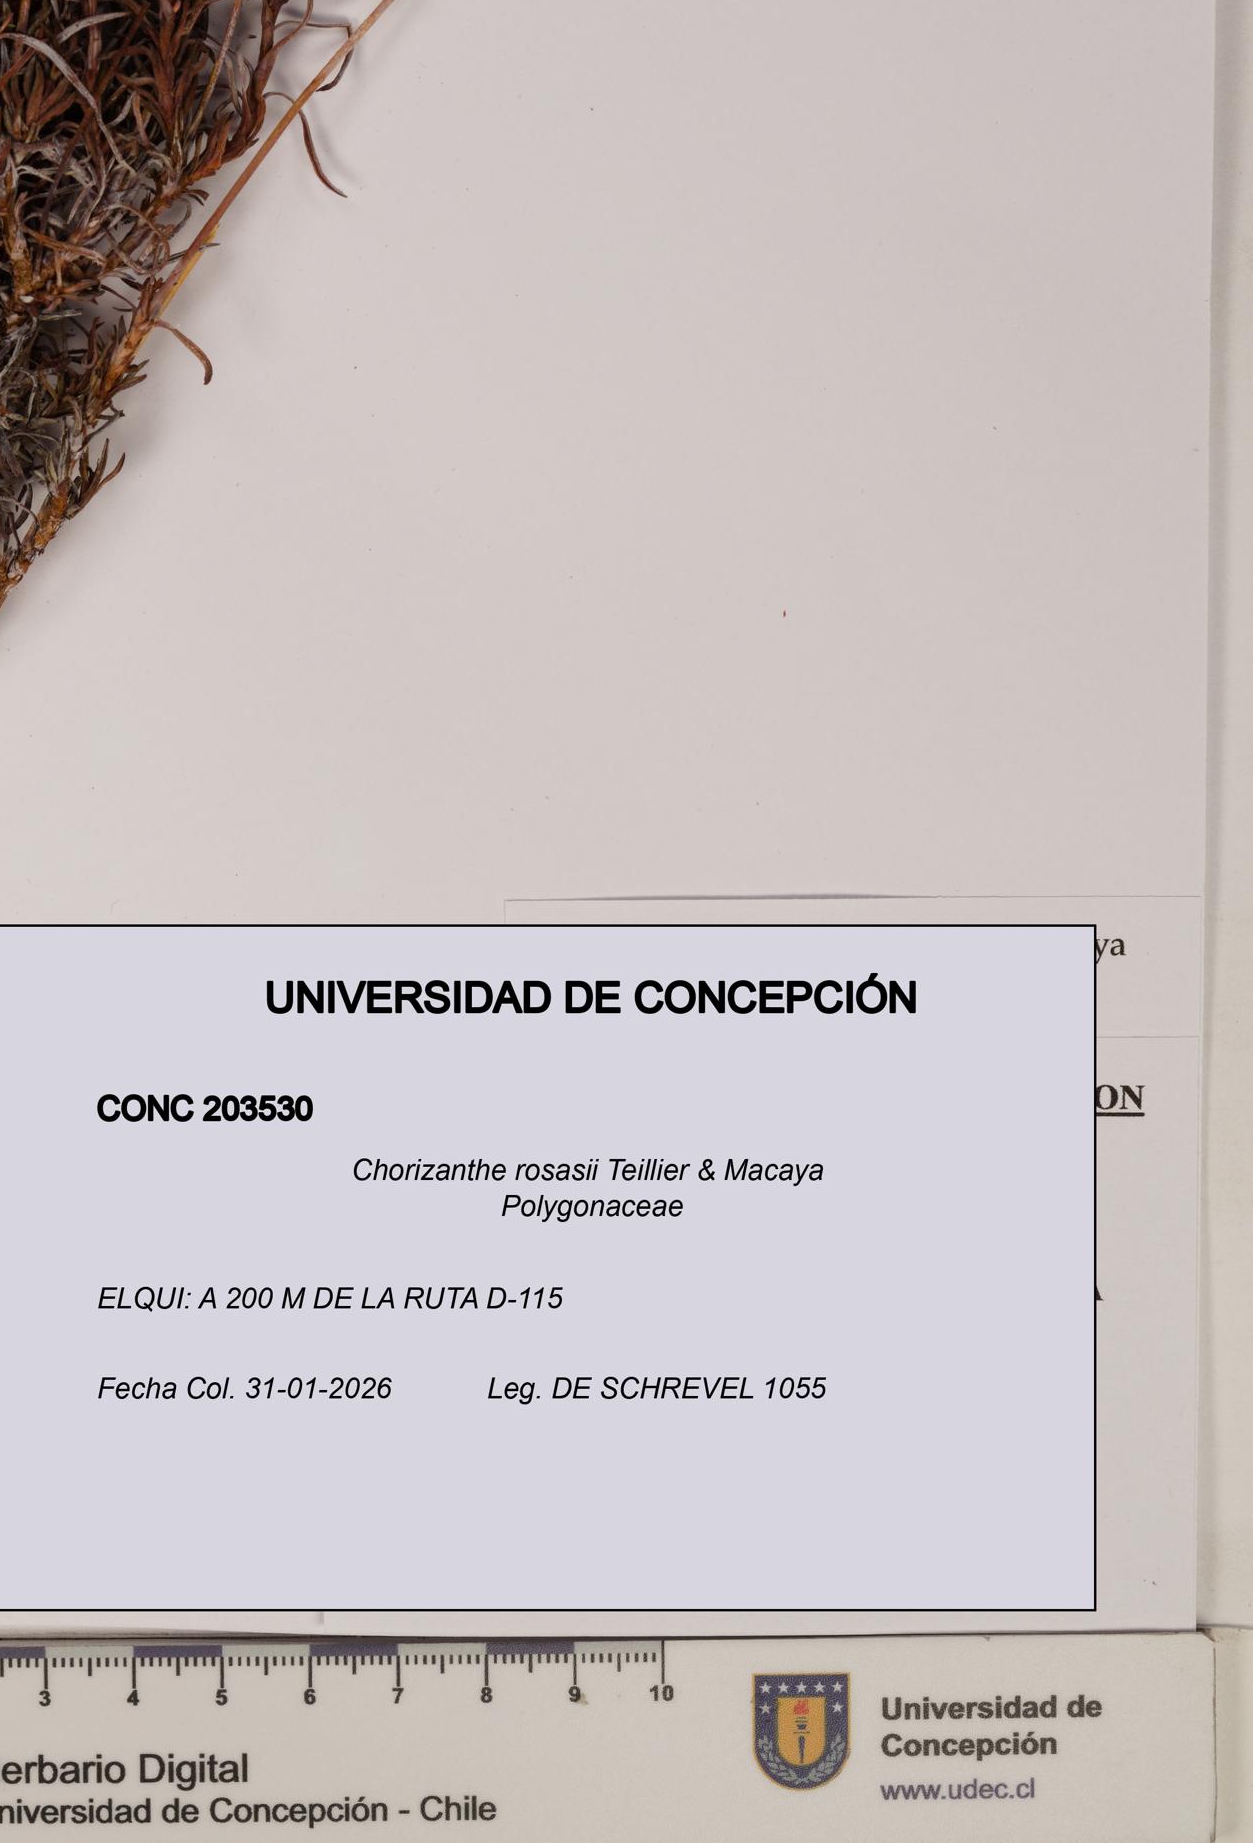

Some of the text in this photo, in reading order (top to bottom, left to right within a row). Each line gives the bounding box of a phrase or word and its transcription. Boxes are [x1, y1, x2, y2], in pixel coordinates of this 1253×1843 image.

[38, 1689, 52, 1707] 3
[126, 1689, 140, 1706] 4
[214, 1688, 229, 1707] 5
[303, 1687, 317, 1705] 6
[391, 1687, 405, 1705] 7
[480, 1686, 494, 1704] 8
[567, 1685, 582, 1703] 9
[649, 1684, 675, 1702] 10
[881, 1694, 1103, 1722] Universidad de
[880, 1731, 1058, 1762] Concepción
[139, 1752, 249, 1791] Digital
[879, 1777, 1035, 1802] www.udec.cl
[161, 1797, 200, 1824] de
[209, 1795, 388, 1826] Concepción
[419, 1795, 497, 1822] Chile
